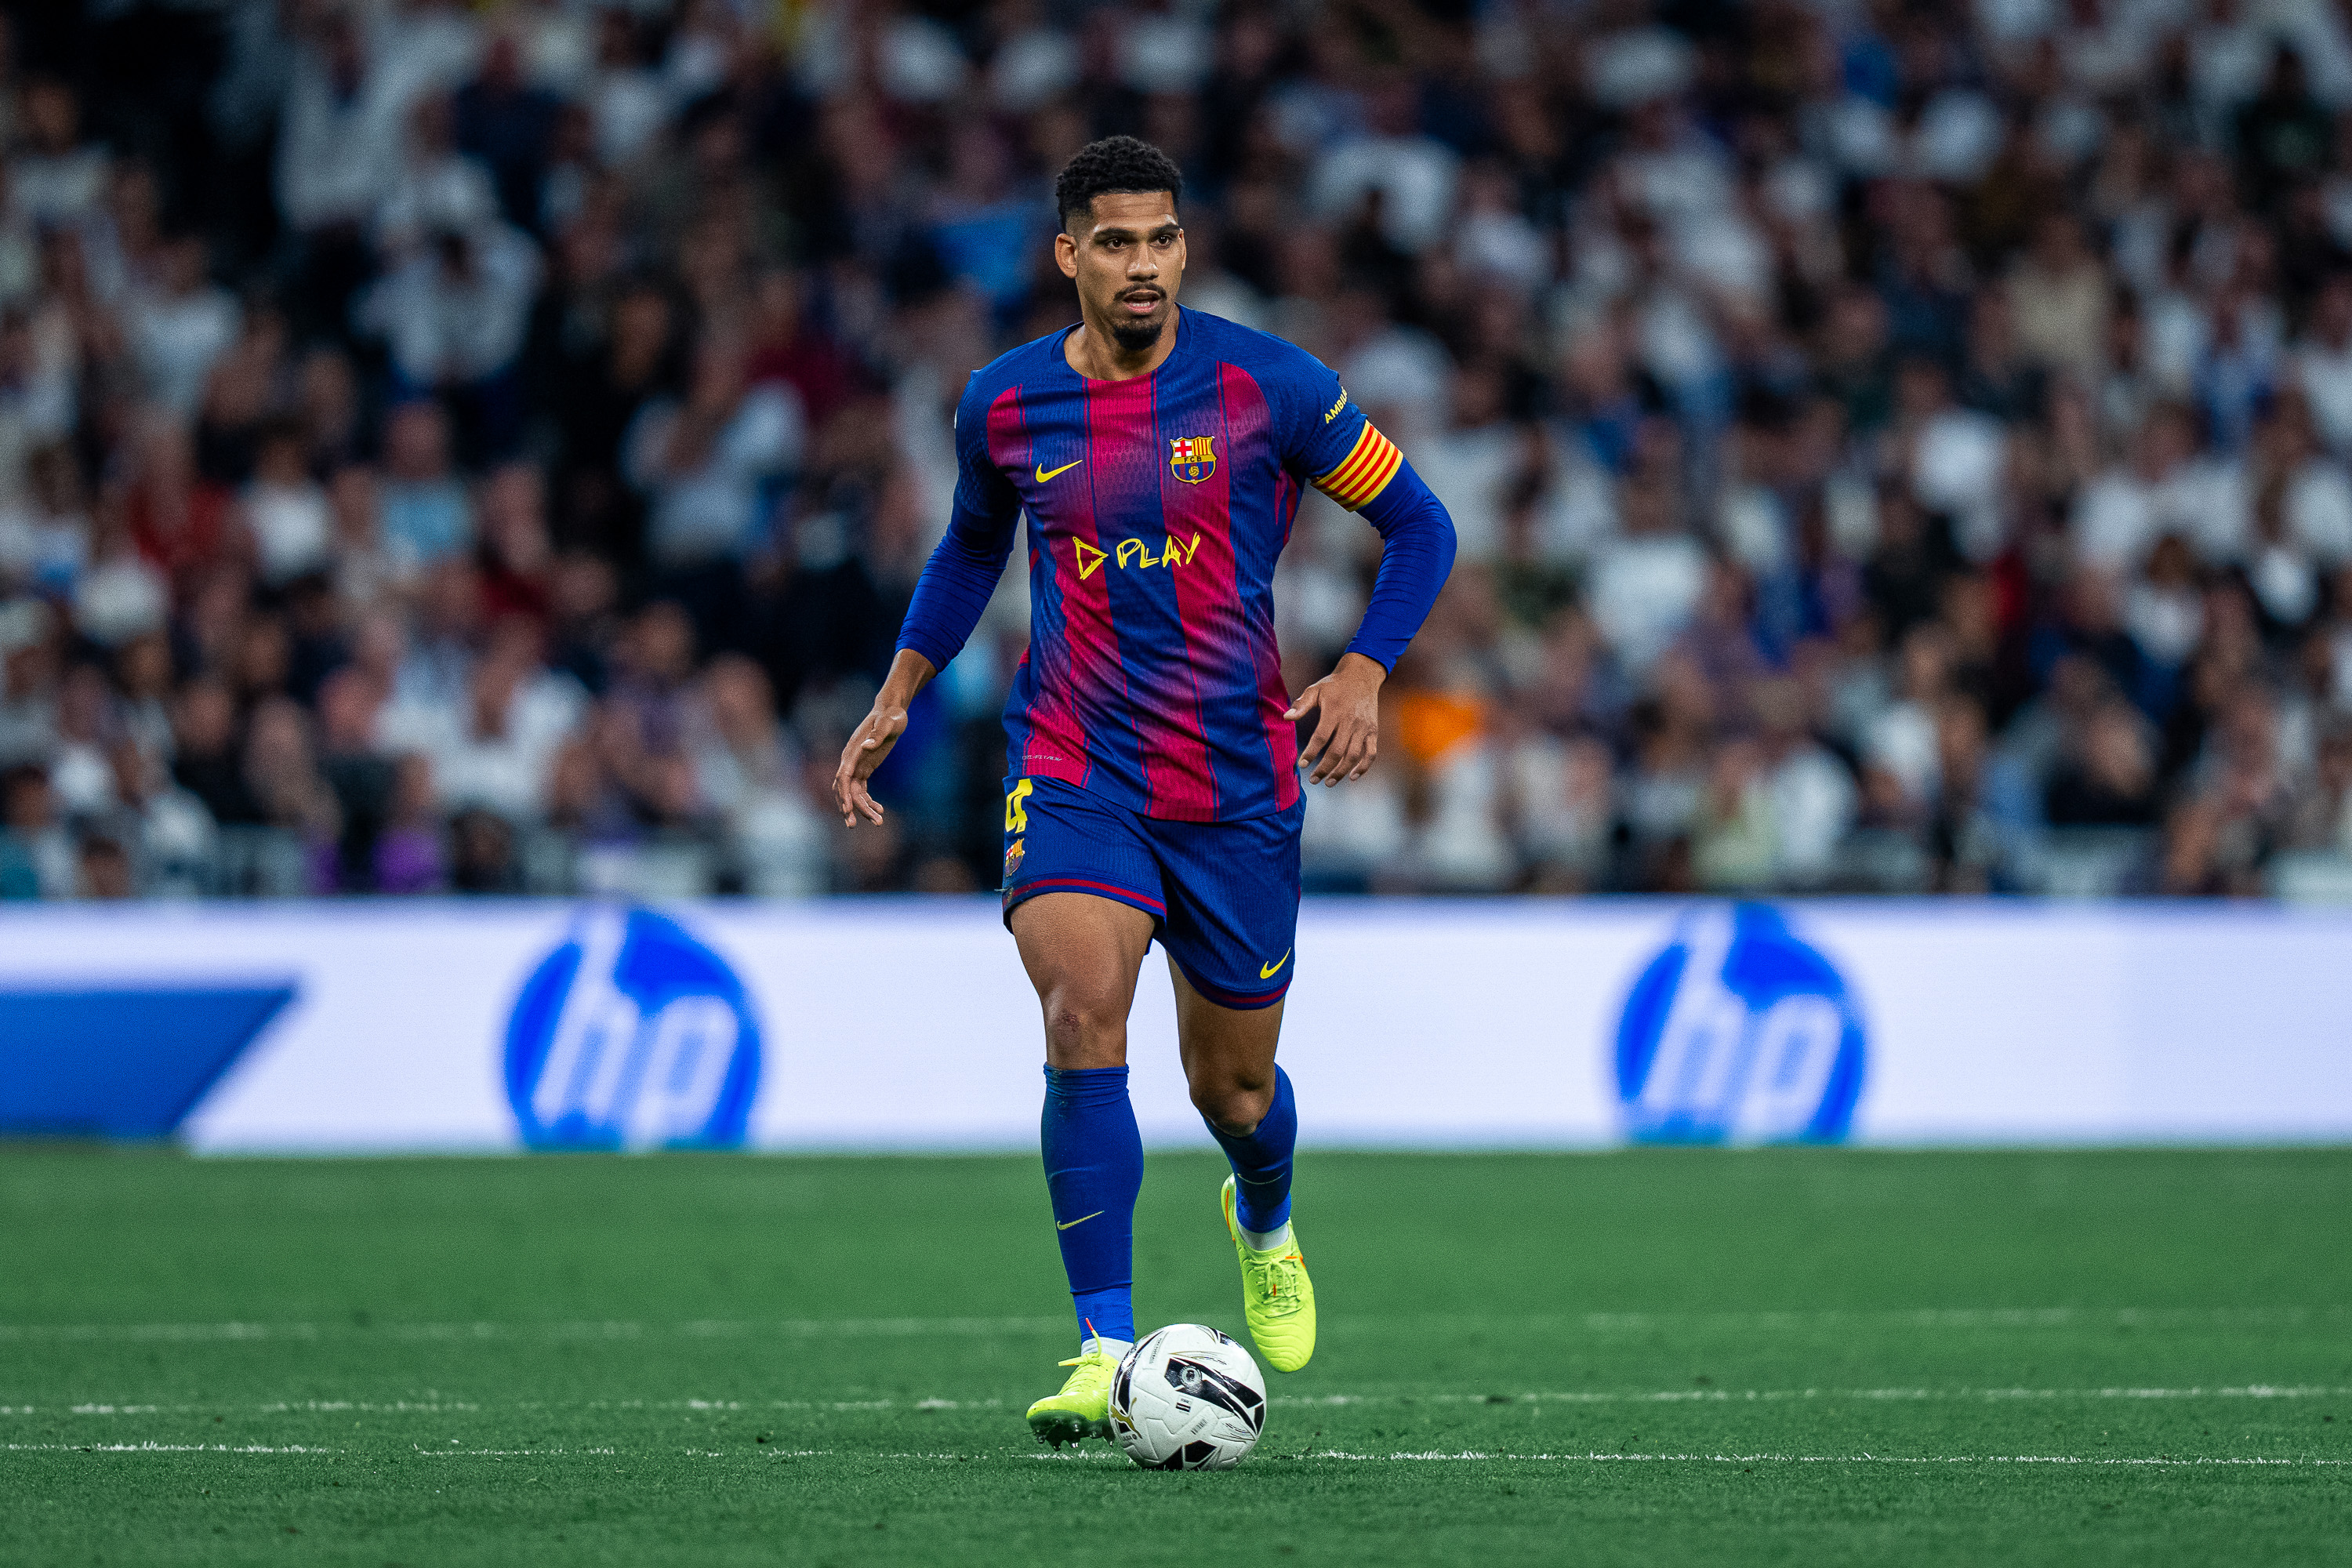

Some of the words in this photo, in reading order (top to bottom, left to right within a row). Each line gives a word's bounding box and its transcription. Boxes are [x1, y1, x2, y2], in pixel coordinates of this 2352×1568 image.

[1116, 532, 1200, 569] PLAY
[530, 889, 741, 1150] hp
[1639, 889, 1844, 1145] hp
